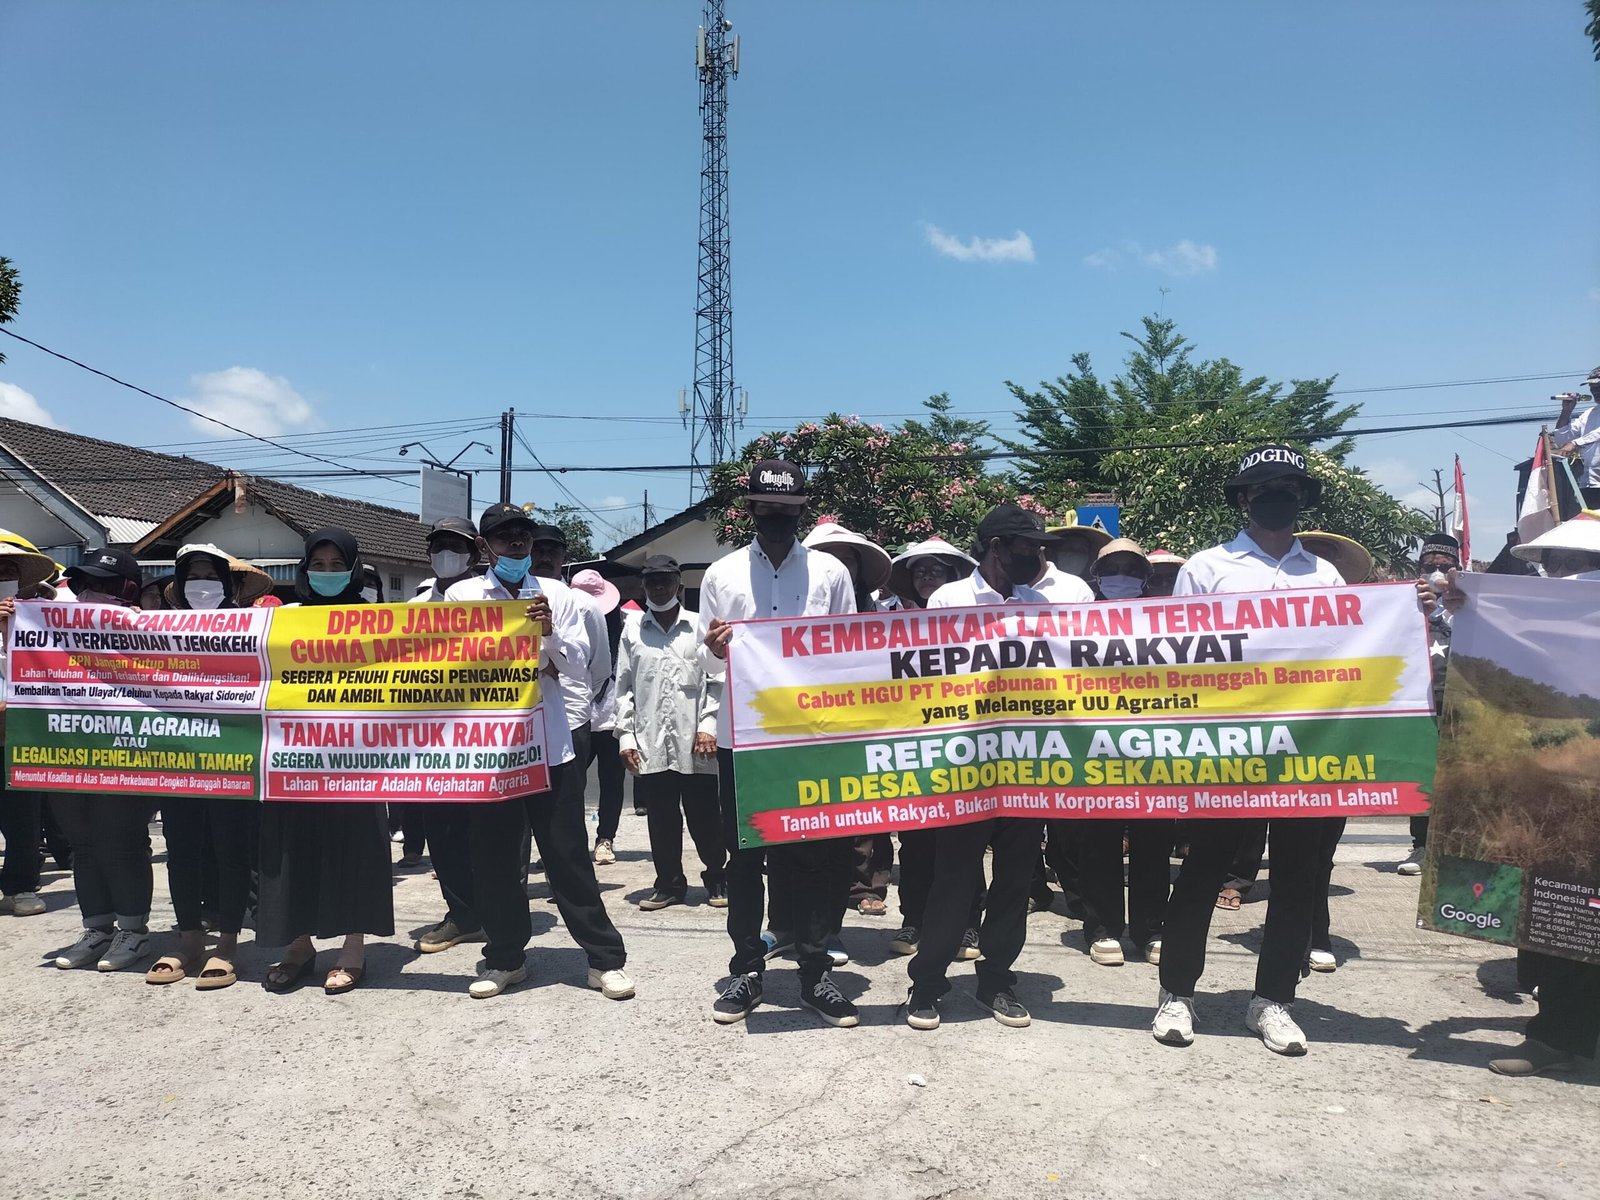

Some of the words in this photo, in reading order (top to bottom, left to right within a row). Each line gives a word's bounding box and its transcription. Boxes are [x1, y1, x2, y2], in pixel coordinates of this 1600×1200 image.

[1239, 449, 1305, 474] ODGING
[41, 606, 96, 630] TOLAK
[327, 610, 394, 635] DPRD
[402, 606, 503, 634] JANGAN
[781, 612, 1007, 658] KEMBALIKAN
[1016, 608, 1133, 637] LAHAN
[1143, 594, 1364, 634] TERLANTAR
[15, 630, 48, 647] HGU
[53, 632, 70, 648] PT
[74, 633, 171, 651] PERKEBUNAN
[173, 636, 257, 652] TJENGKEH!
[290, 638, 368, 664] CUMA
[374, 635, 538, 663] MENDENGAR!
[69, 656, 91, 667] BPN
[95, 656, 128, 670] Jangan
[132, 658, 164, 671] Tutup
[168, 658, 200, 669] Mata!
[890, 640, 1056, 679] KEPADA
[1070, 633, 1249, 668] RAKYAT
[20, 668, 46, 678] Lahan
[48, 669, 83, 679] Puluhan
[86, 670, 112, 679] Tahun
[114, 671, 150, 682] Terlantar
[152, 672, 169, 682] dan
[172, 672, 250, 685] Dialihfungsikan!
[281, 670, 333, 684] SEGERA
[337, 670, 388, 684] PENUHI
[392, 669, 444, 684] FUNGSI
[797, 690, 856, 710] Cabut
[862, 686, 903, 705] HGU
[910, 683, 935, 701] PT
[941, 676, 1057, 698] Perkebunan
[1063, 672, 1159, 695] Tjengkeh
[1167, 668, 1268, 691] Branggah
[1274, 666, 1362, 685] Banaran
[15, 685, 60, 696] Kembalikan
[62, 686, 86, 697] Tanah
[89, 687, 152, 699] Ulayat/Leluhur
[153, 689, 182, 701] Kepada
[184, 690, 214, 703] Rakyat
[216, 690, 256, 703] Sidorejo!
[307, 688, 336, 703] DAN
[340, 688, 385, 703] AMBIL
[390, 688, 465, 703] TINDAKAN
[470, 688, 519, 702] NYATA!
[922, 704, 969, 724] yang
[975, 696, 1076, 715] Melanggar
[1082, 696, 1109, 711] UU
[1116, 694, 1198, 714] Agraria!
[48, 714, 133, 735] REFORMA
[139, 716, 220, 738] AGRARIA
[280, 722, 354, 748] TANAH
[362, 722, 446, 747] UNTUK
[113, 737, 147, 748] ATAU
[865, 730, 1072, 773] REFORMA
[1087, 724, 1299, 758] AGRARIA
[13, 746, 88, 766] LEGALISASI
[92, 750, 195, 769] PENELANTARAN
[199, 753, 253, 772] TANAH?
[272, 752, 325, 769] SEGERA
[328, 752, 411, 769] WUJUDKAN
[415, 752, 450, 770] TORA
[456, 752, 469, 769] DI
[474, 745, 541, 769] SIDOREJO!
[15, 770, 46, 782] Menuntut
[48, 771, 75, 783] Keadilan
[76, 772, 82, 784] di
[84, 774, 98, 784] Atas
[100, 774, 118, 785] Tanah
[120, 774, 158, 786] Perkebunan
[160, 776, 188, 790] Cengkeh
[189, 777, 221, 791] Branggah
[222, 778, 250, 790] Banaran
[283, 776, 319, 792] Lahan
[323, 776, 378, 793] Terlantar
[381, 776, 422, 792] Adalah
[426, 776, 485, 795] Kejahatan
[488, 772, 529, 795] Agraria
[798, 780, 829, 806] DI
[840, 772, 922, 802] DESA
[930, 760, 1073, 793] SIDOREJO
[1084, 758, 1267, 785] SEKARANG
[1278, 754, 1376, 782] JUGA!
[781, 814, 830, 833] Tanah
[835, 808, 883, 827] untuk
[888, 801, 950, 823] Rakyat,
[955, 794, 997, 816] Bukan
[1002, 792, 1049, 809] untuk
[1055, 792, 1140, 813] Korporasi
[1146, 794, 1187, 812] yang
[1194, 790, 1332, 809] Menelantarkan
[1337, 788, 1398, 806] Lahan!
[1534, 888, 1585, 905] Indonesia
[1535, 876, 1595, 895] Kecamatan
[1441, 904, 1501, 929] Google
[1532, 914, 1551, 922] Timur
[1552, 902, 1572, 911] Tanpa
[1553, 911, 1570, 919] Jawa
[1572, 914, 1592, 922] Timur
[1529, 936, 1546, 944] Note
[1550, 940, 1583, 951] Captured
[1584, 946, 1593, 954] by
[1574, 930, 1592, 938] Long
